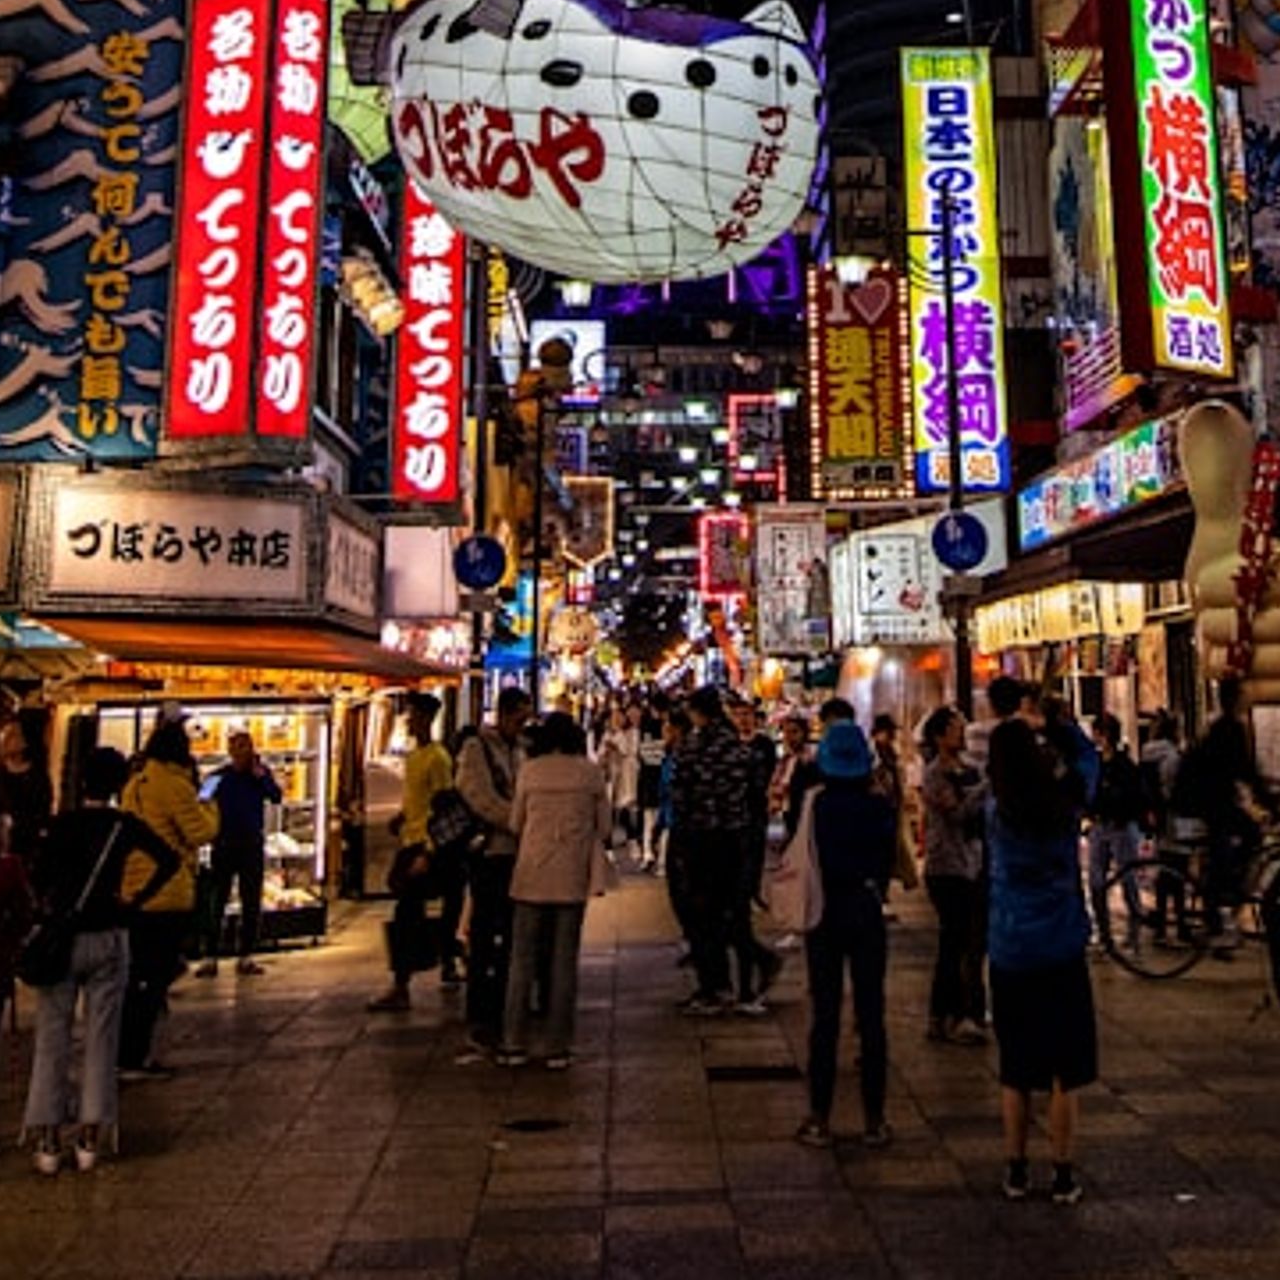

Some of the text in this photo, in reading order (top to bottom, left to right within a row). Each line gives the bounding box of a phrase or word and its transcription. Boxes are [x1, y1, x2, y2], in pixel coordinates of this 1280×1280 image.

[1143, 84, 1222, 312] 横綱
[187, 191, 245, 413] てっちり
[263, 191, 311, 422] てっちり
[918, 298, 999, 446] 横綱
[1165, 312, 1226, 369] 酒処
[67, 521, 291, 569] づぼらや本店
